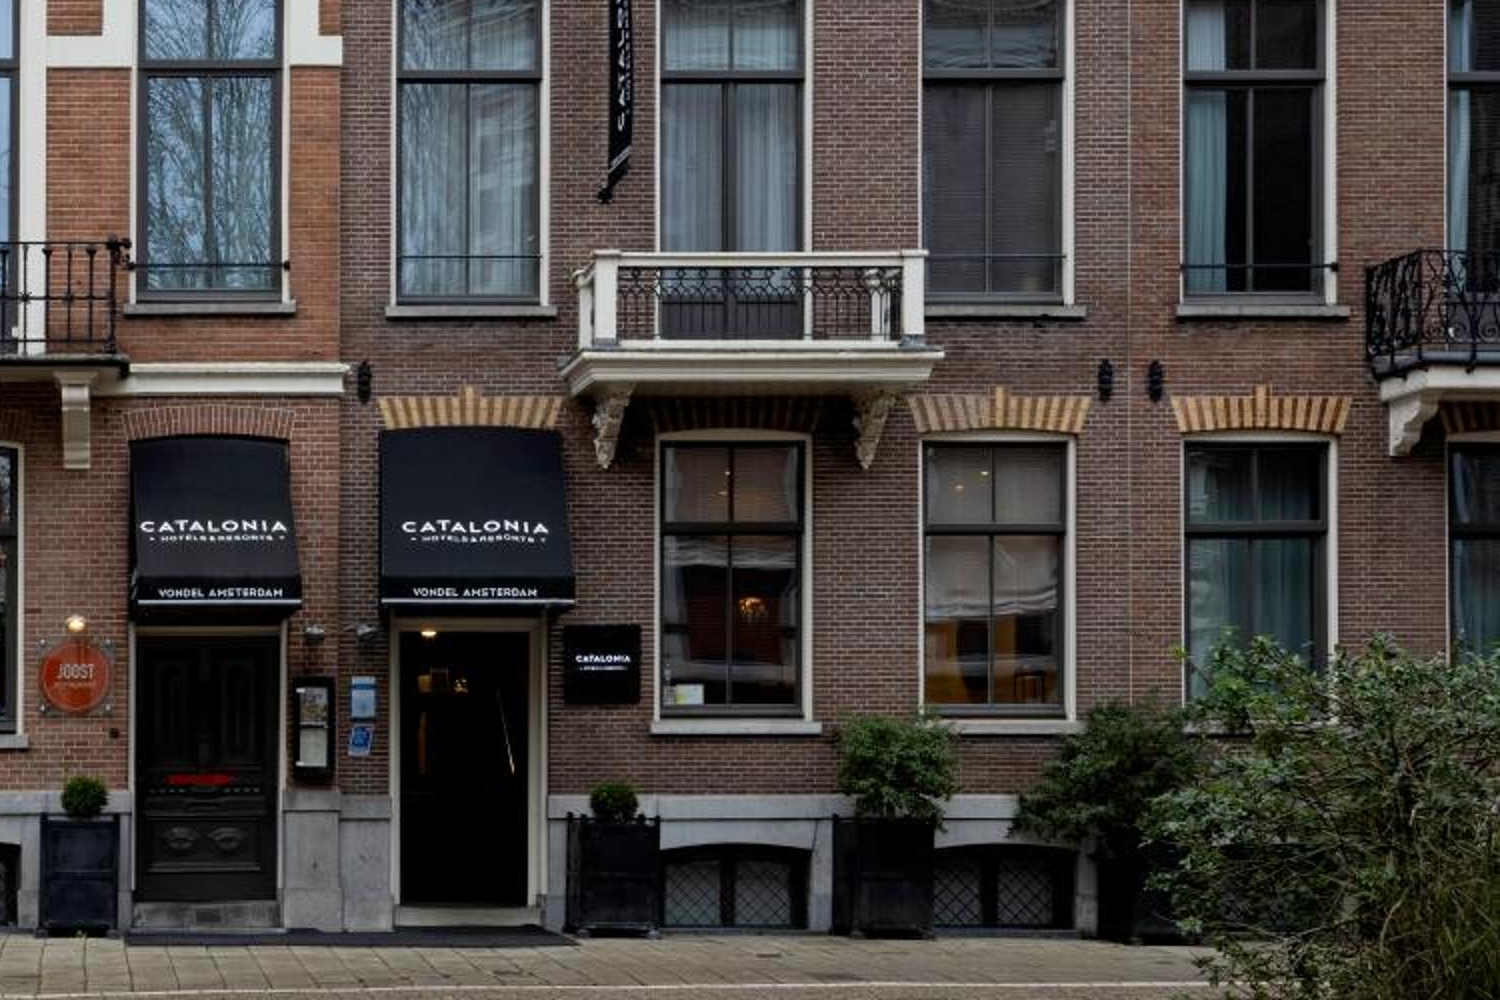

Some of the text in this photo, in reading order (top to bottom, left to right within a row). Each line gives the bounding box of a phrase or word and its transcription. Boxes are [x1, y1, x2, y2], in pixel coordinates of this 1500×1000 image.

[139, 519, 287, 533] CATALONIA
[401, 519, 549, 534] CATALONIA
[158, 587, 283, 598] VONDEL AMSTERDAM
[412, 587, 538, 597] VONDEL AMSTERDAM
[575, 654, 631, 663] CATALONIA
[56, 663, 94, 679] JOOST
